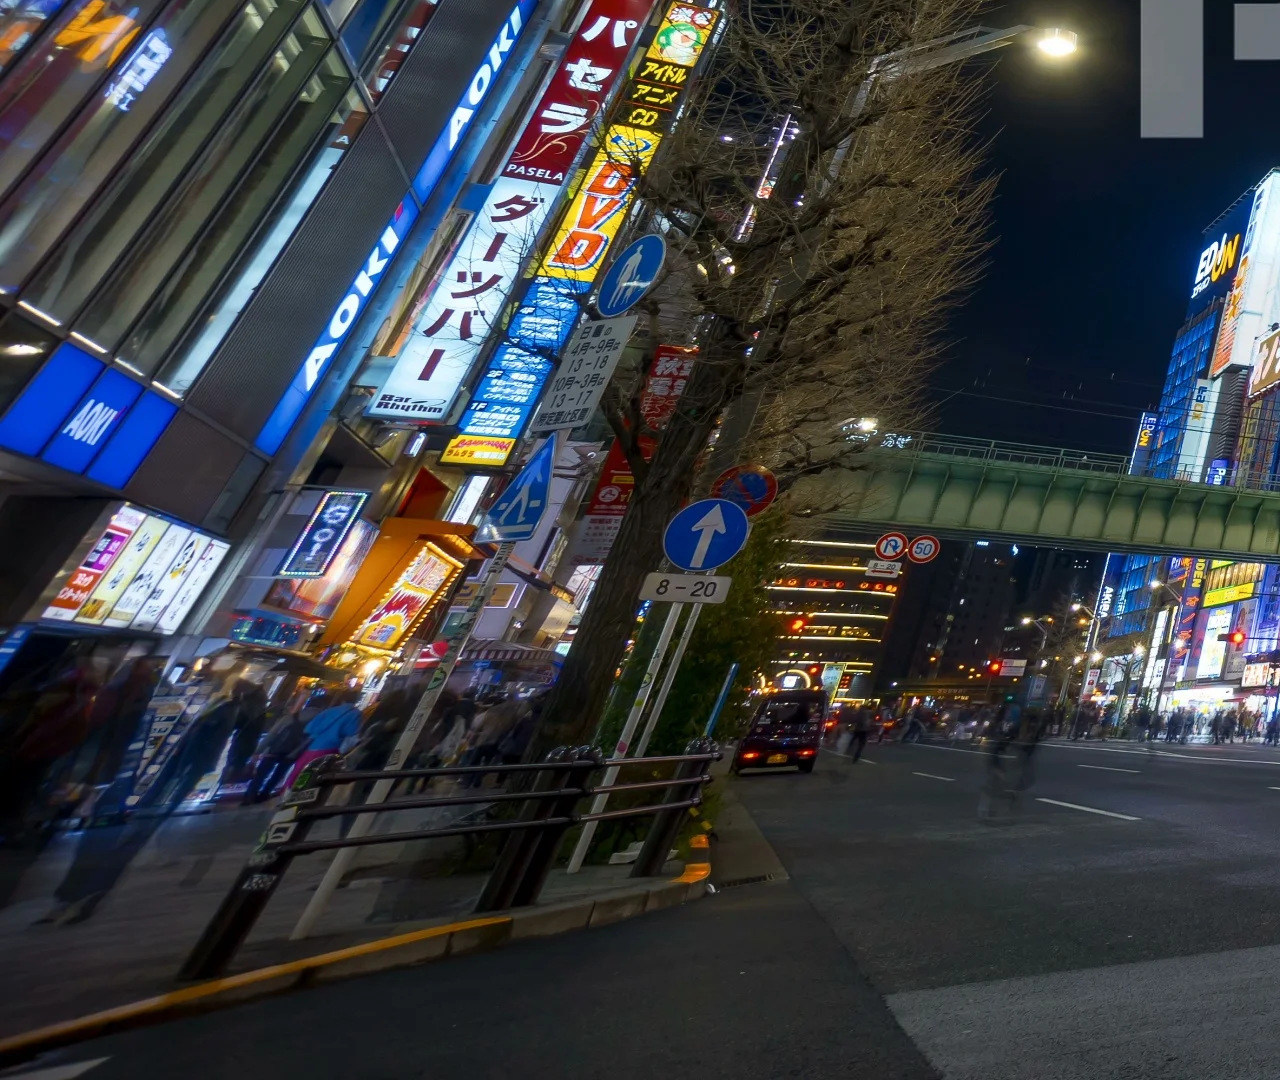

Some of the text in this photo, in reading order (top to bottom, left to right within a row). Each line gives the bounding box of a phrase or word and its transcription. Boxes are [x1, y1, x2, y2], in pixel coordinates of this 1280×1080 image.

[448, 6, 521, 150] AOKI
[641, 61, 687, 85] アイドル
[632, 83, 678, 105] アニメ
[628, 108, 659, 127] CD
[506, 161, 565, 183] PASELA
[547, 162, 638, 271] DVD
[418, 194, 544, 383] ダーツバー
[305, 225, 400, 393] AOKI
[376, 398, 444, 416] Rhythm
[380, 393, 414, 406] Bar
[470, 402, 488, 411] 1F
[62, 399, 119, 447] AOKI
[914, 542, 933, 556] 50
[656, 578, 717, 599] 8-20
